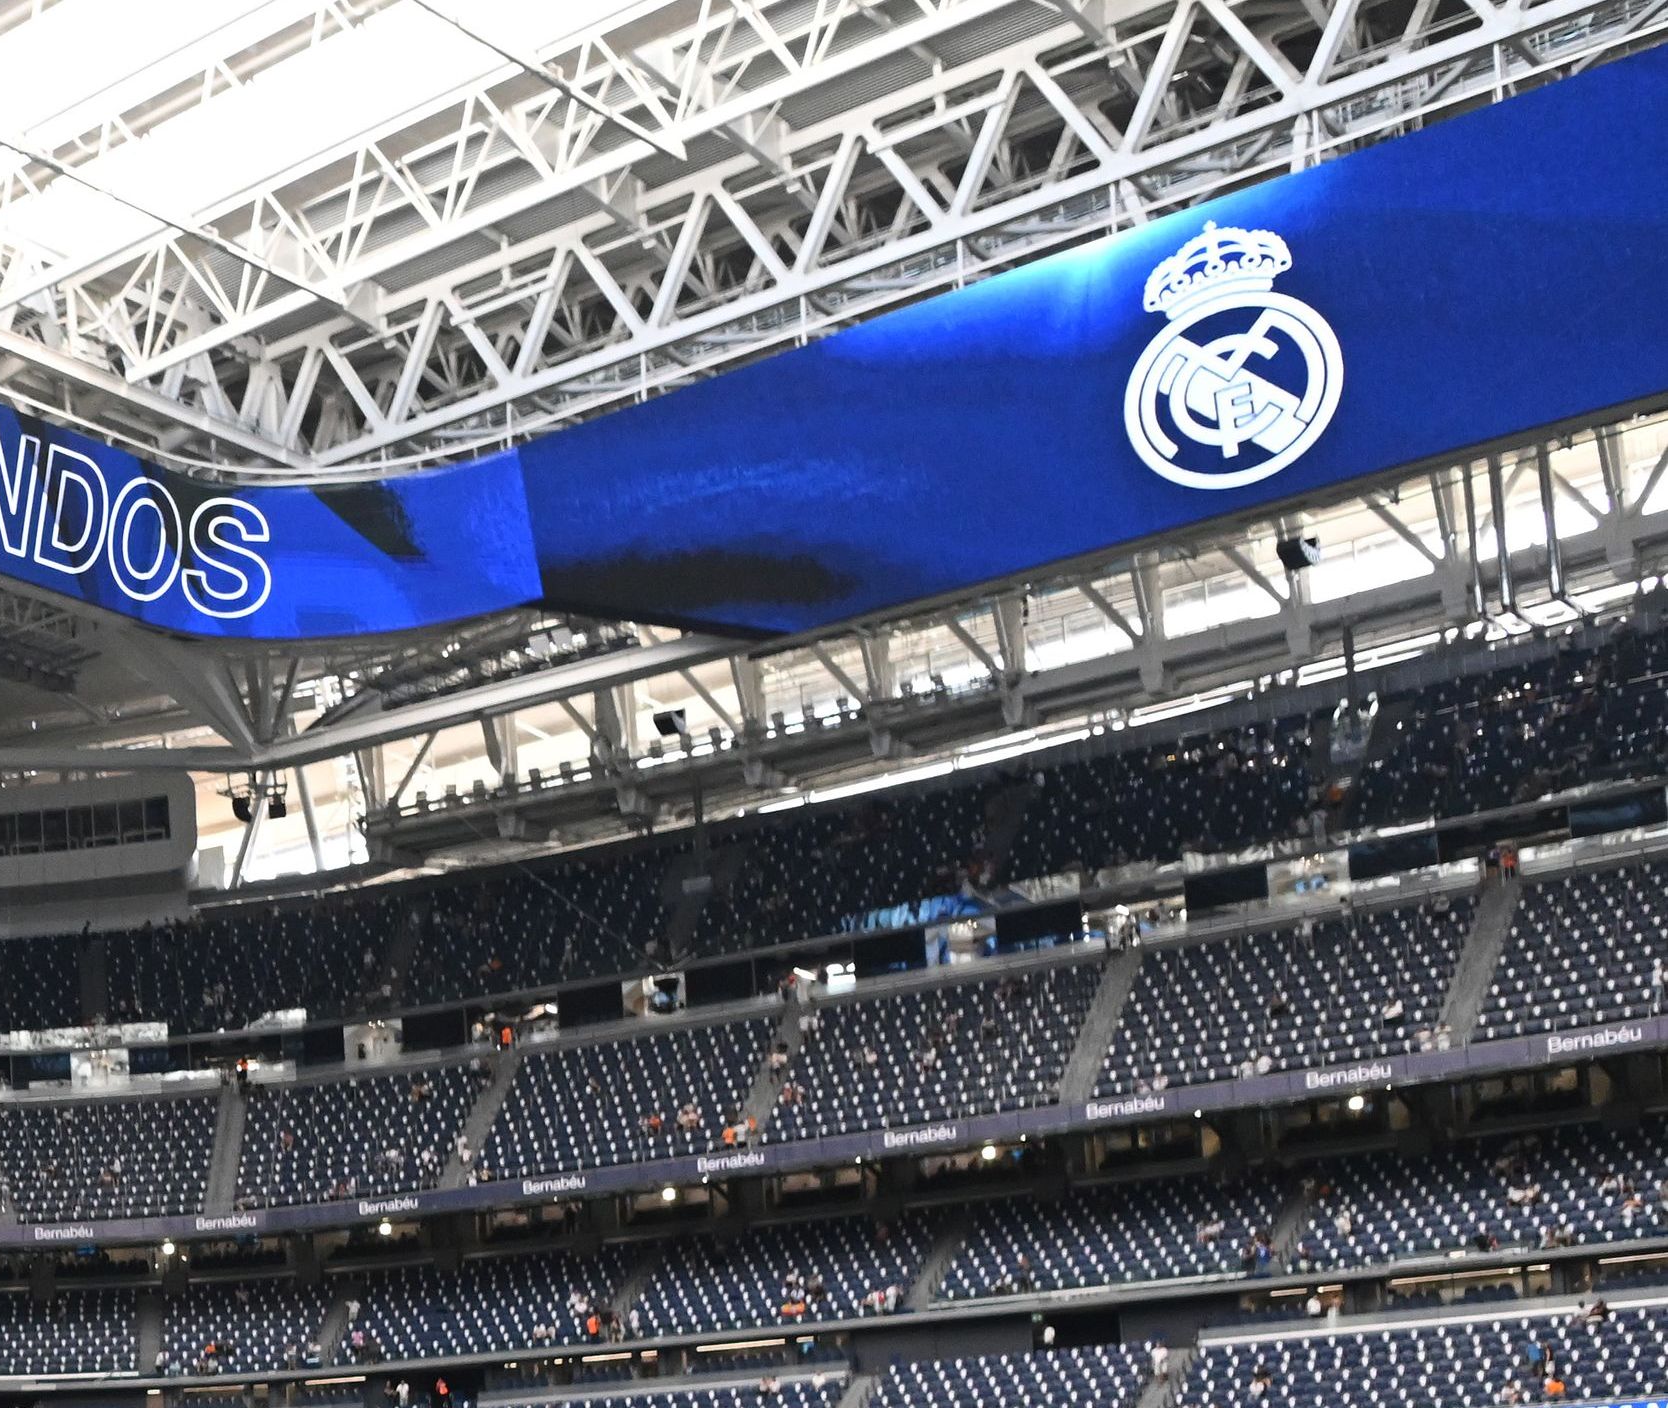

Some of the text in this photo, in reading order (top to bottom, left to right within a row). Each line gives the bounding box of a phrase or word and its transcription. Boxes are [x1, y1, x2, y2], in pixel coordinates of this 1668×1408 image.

[1548, 1026, 1642, 1053] Bernabéu
[1306, 1063, 1391, 1089] Bernabéu
[1086, 1096, 1164, 1120] Bernabéu
[884, 1125, 956, 1148] Bernabéu
[697, 1151, 764, 1172] Bernabéu
[523, 1175, 586, 1195] Bernabéu
[359, 1197, 418, 1215] Bernabéu
[196, 1214, 256, 1230] Bernabéu
[35, 1226, 94, 1240] Bernabéu
